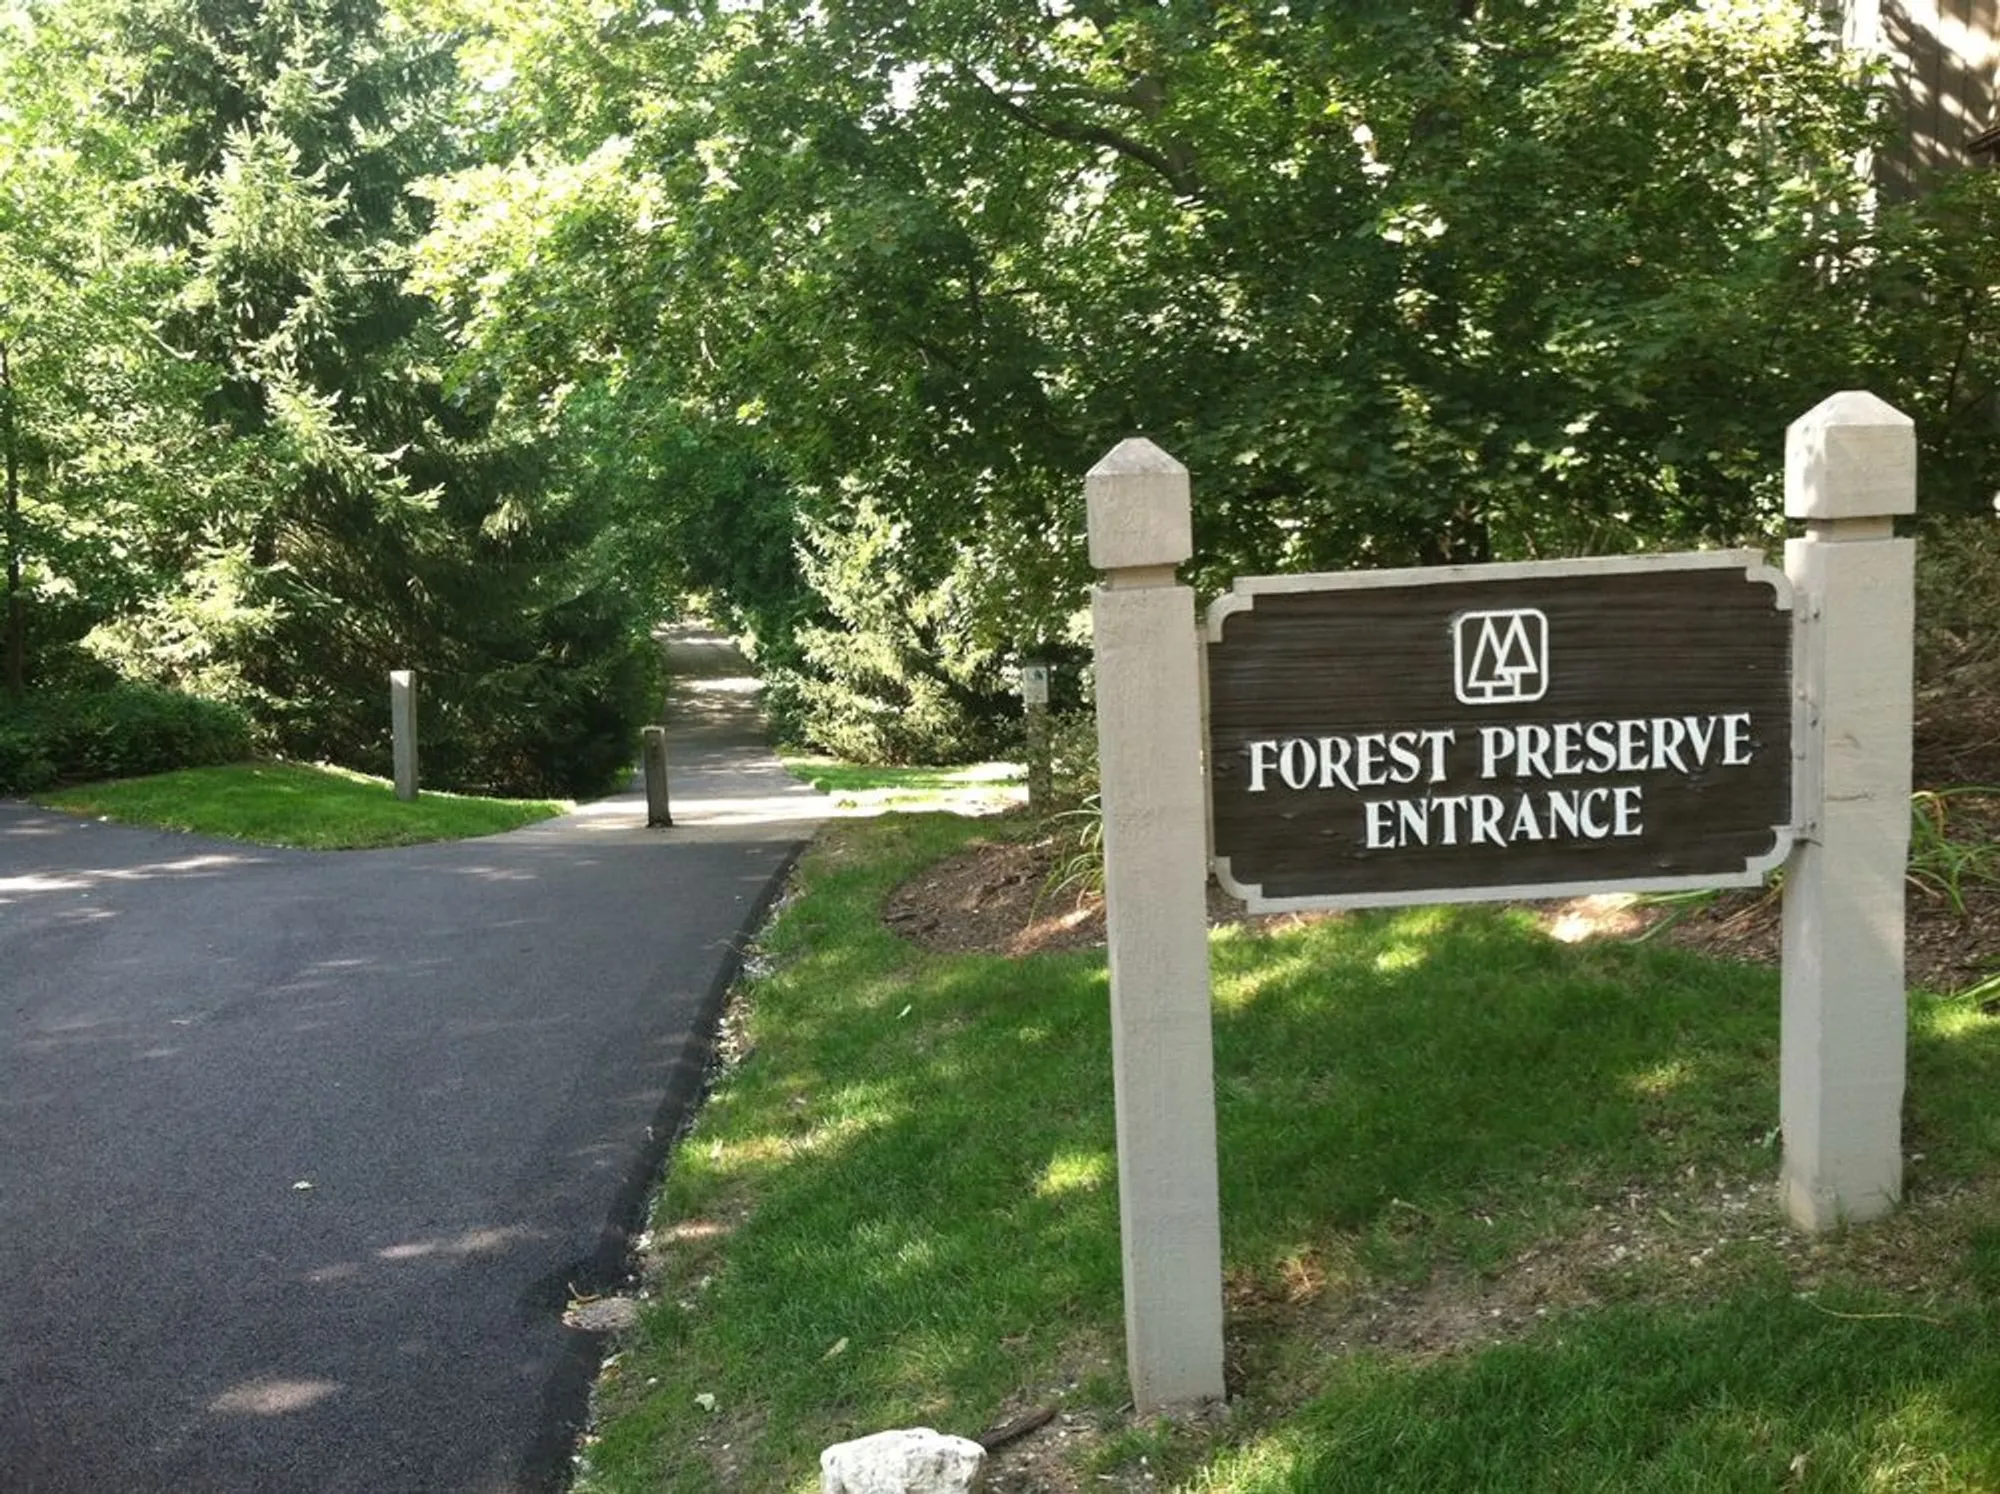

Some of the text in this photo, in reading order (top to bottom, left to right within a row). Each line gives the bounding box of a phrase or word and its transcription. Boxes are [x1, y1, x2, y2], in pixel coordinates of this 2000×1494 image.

[1248, 713, 1752, 793] FOREST PRESERVE
[1365, 786, 1643, 849] ENTRANCE
